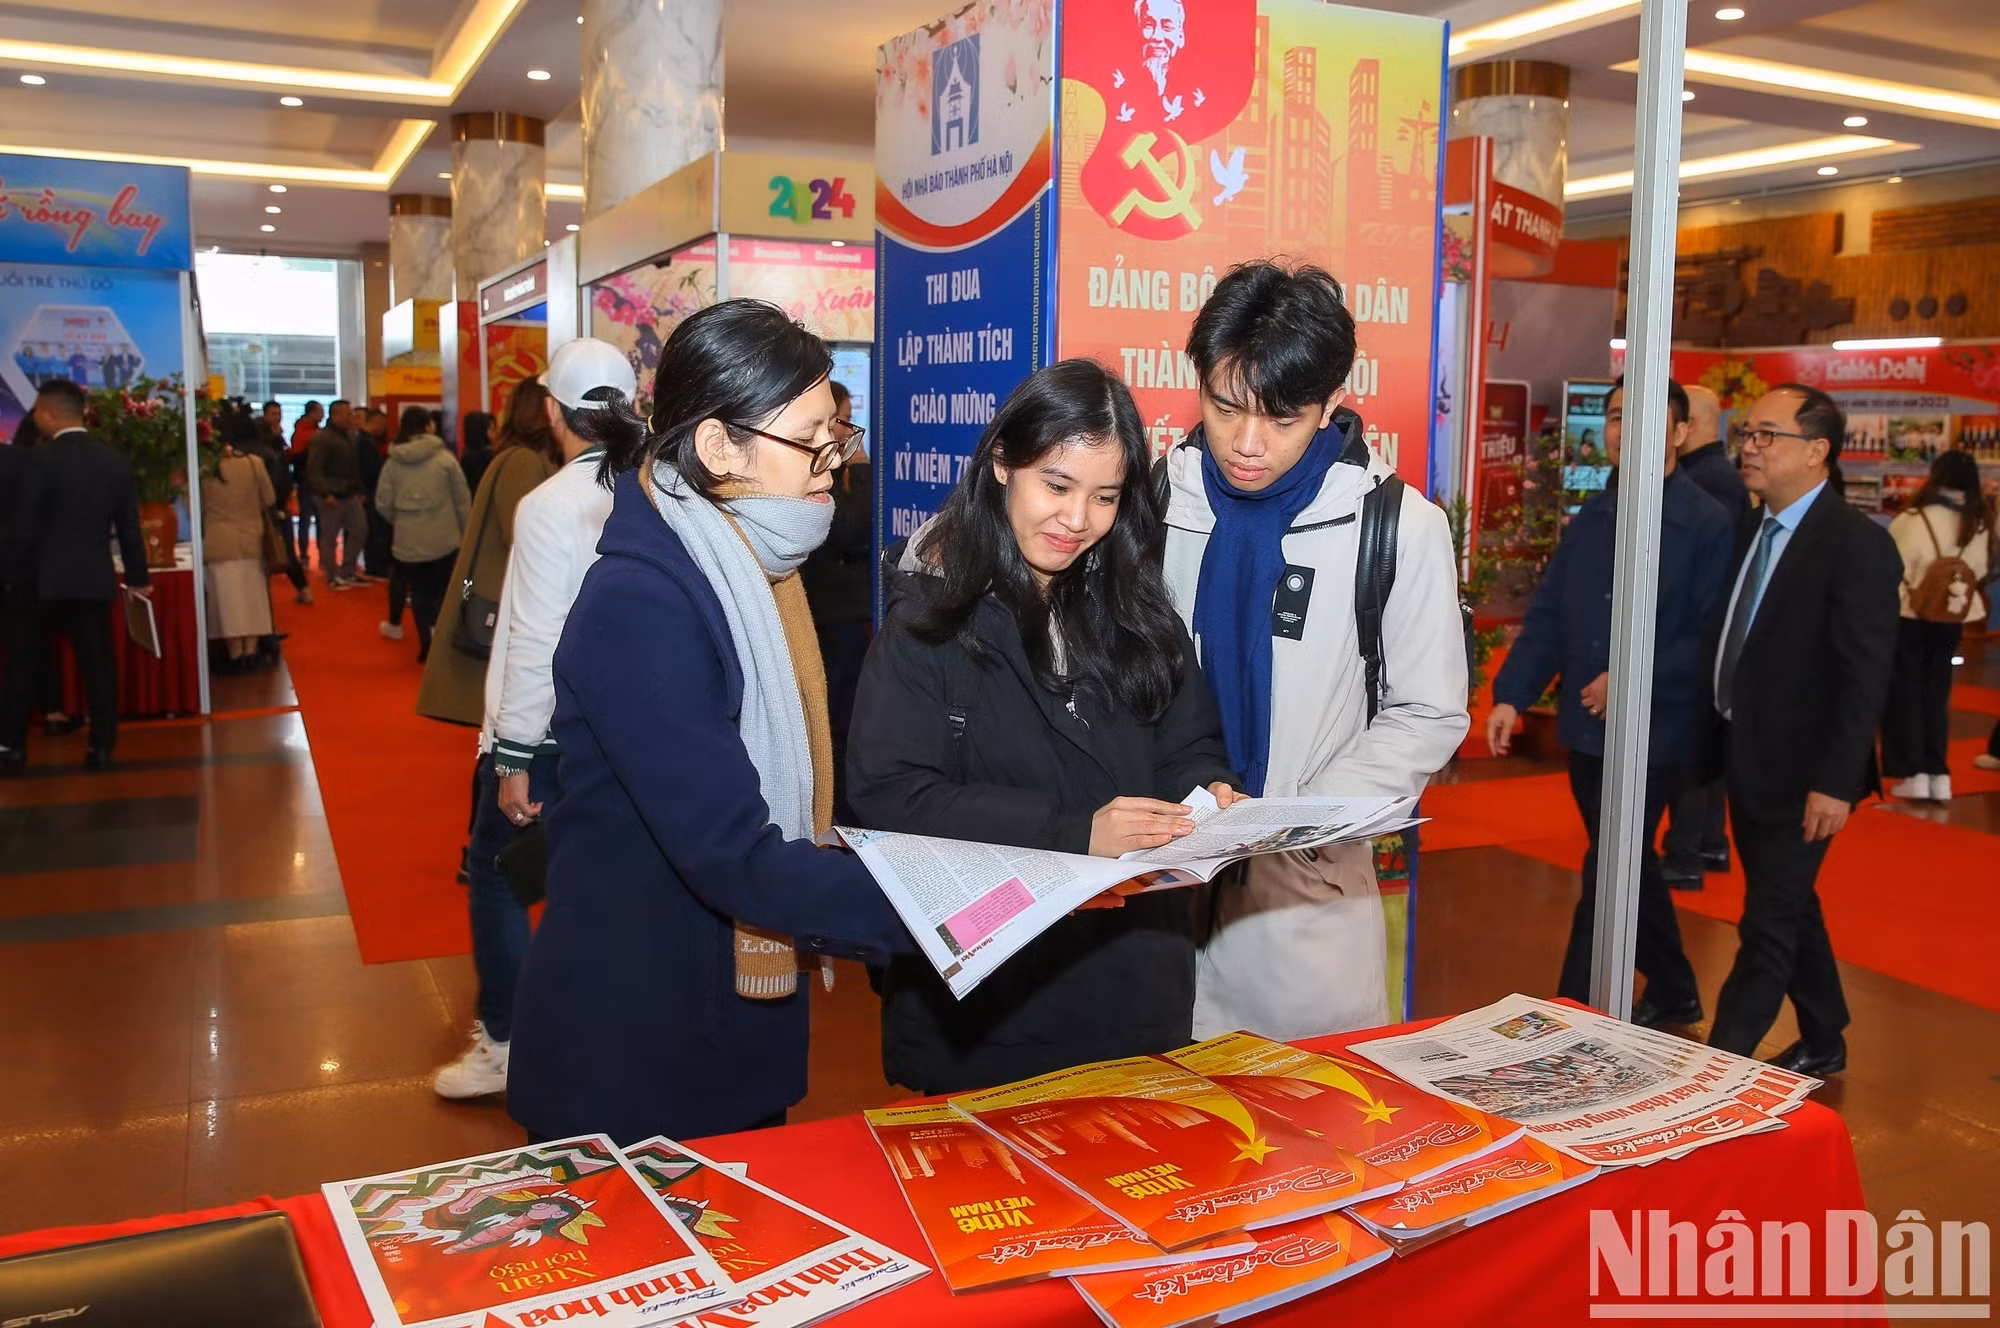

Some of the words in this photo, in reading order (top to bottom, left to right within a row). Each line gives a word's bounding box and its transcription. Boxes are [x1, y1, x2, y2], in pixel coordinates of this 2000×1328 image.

[945, 166, 969, 189] THÀNH
[999, 150, 1013, 177] NỘI
[107, 184, 167, 256] bay
[926, 273, 948, 304] THI
[951, 268, 981, 302] ĐUA
[1088, 254, 1170, 311] ĐẢNG
[1355, 277, 1409, 324] DÂN
[898, 330, 923, 373] LẬP
[927, 327, 973, 365] THÀNH
[977, 323, 1013, 362] TÍCH
[1120, 340, 1200, 390] THÀN
[910, 388, 947, 425] CHÀO
[951, 387, 996, 425] MỪNG
[895, 442, 913, 481] KỶ
[915, 447, 951, 490] NIỆM
[1105, 1171, 1145, 1188] NAM
[949, 1201, 992, 1219] NAM
[957, 1212, 1003, 1235] thế
[495, 1266, 596, 1293] Xuân
[809, 1246, 894, 1287] Tinh
[607, 1268, 715, 1307] Tinh
[515, 1294, 610, 1327] hoa
